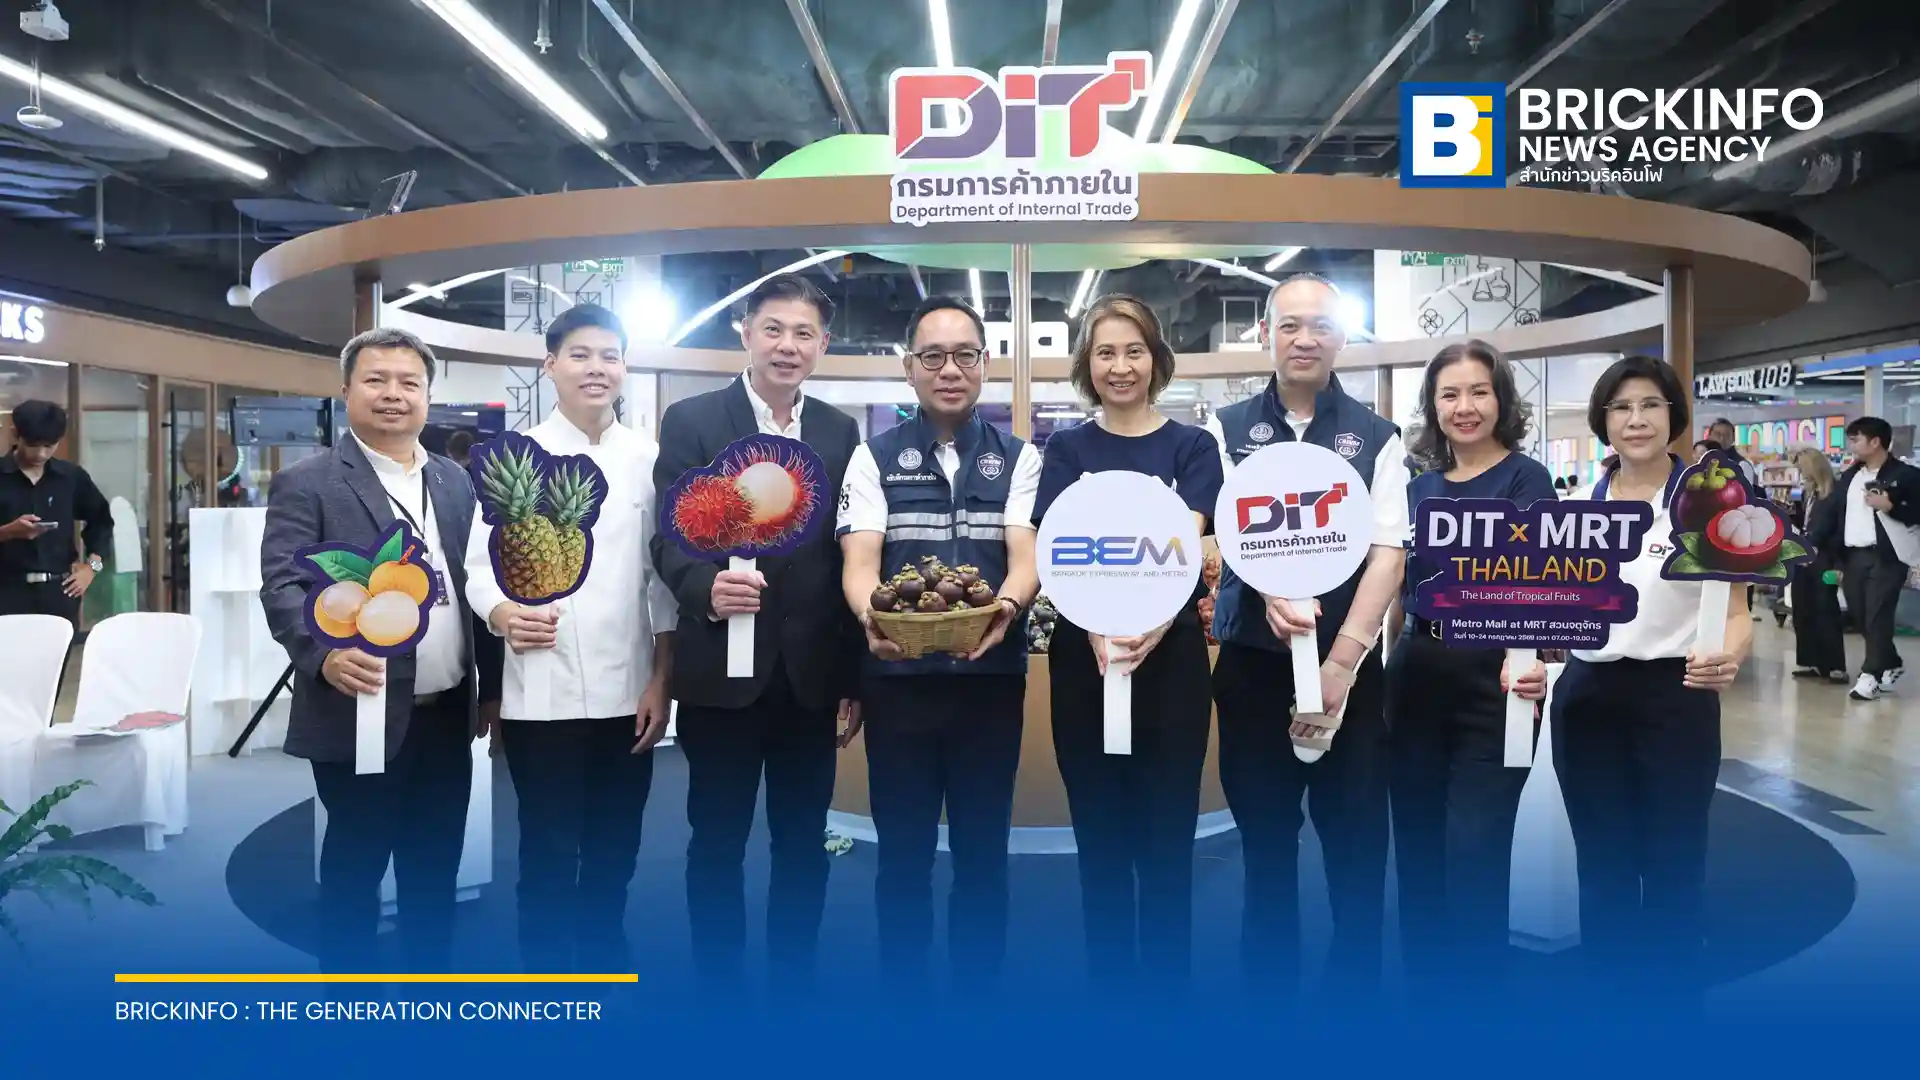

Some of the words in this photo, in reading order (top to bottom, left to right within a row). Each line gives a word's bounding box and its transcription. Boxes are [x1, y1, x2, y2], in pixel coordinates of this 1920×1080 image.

[896, 168, 1132, 198] กรมการค้าภายใน
[896, 204, 995, 221] Department
[999, 203, 1014, 216] of
[1018, 203, 1081, 216] Internal
[1086, 203, 1133, 216] Trade
[0, 301, 45, 343] KS
[1698, 368, 1755, 397] LAWSON
[1758, 362, 1792, 389] 108
[1240, 530, 1347, 552] กรมการค้าภายใน
[1428, 511, 1505, 547] DIT
[1540, 512, 1641, 550] MRT
[1051, 536, 1188, 566] BEM
[1240, 550, 1286, 561] Department
[1286, 548, 1294, 556] of
[1326, 545, 1348, 553] Trade
[1051, 570, 1086, 578] BANGKOK
[1143, 570, 1159, 578] AND
[1162, 570, 1188, 578] METRO
[1450, 555, 1607, 583] THAILAND
[1460, 590, 1479, 600] The
[1480, 590, 1504, 601] Land
[1505, 590, 1515, 601] of
[1516, 590, 1553, 604] Tropical
[1555, 592, 1580, 602] Fruits
[1451, 618, 1483, 629] Metro
[1485, 619, 1507, 629] Mall
[1510, 620, 1521, 629] at
[1523, 620, 1547, 629] MRT
[1549, 620, 1602, 632] สวนจตุจักร
